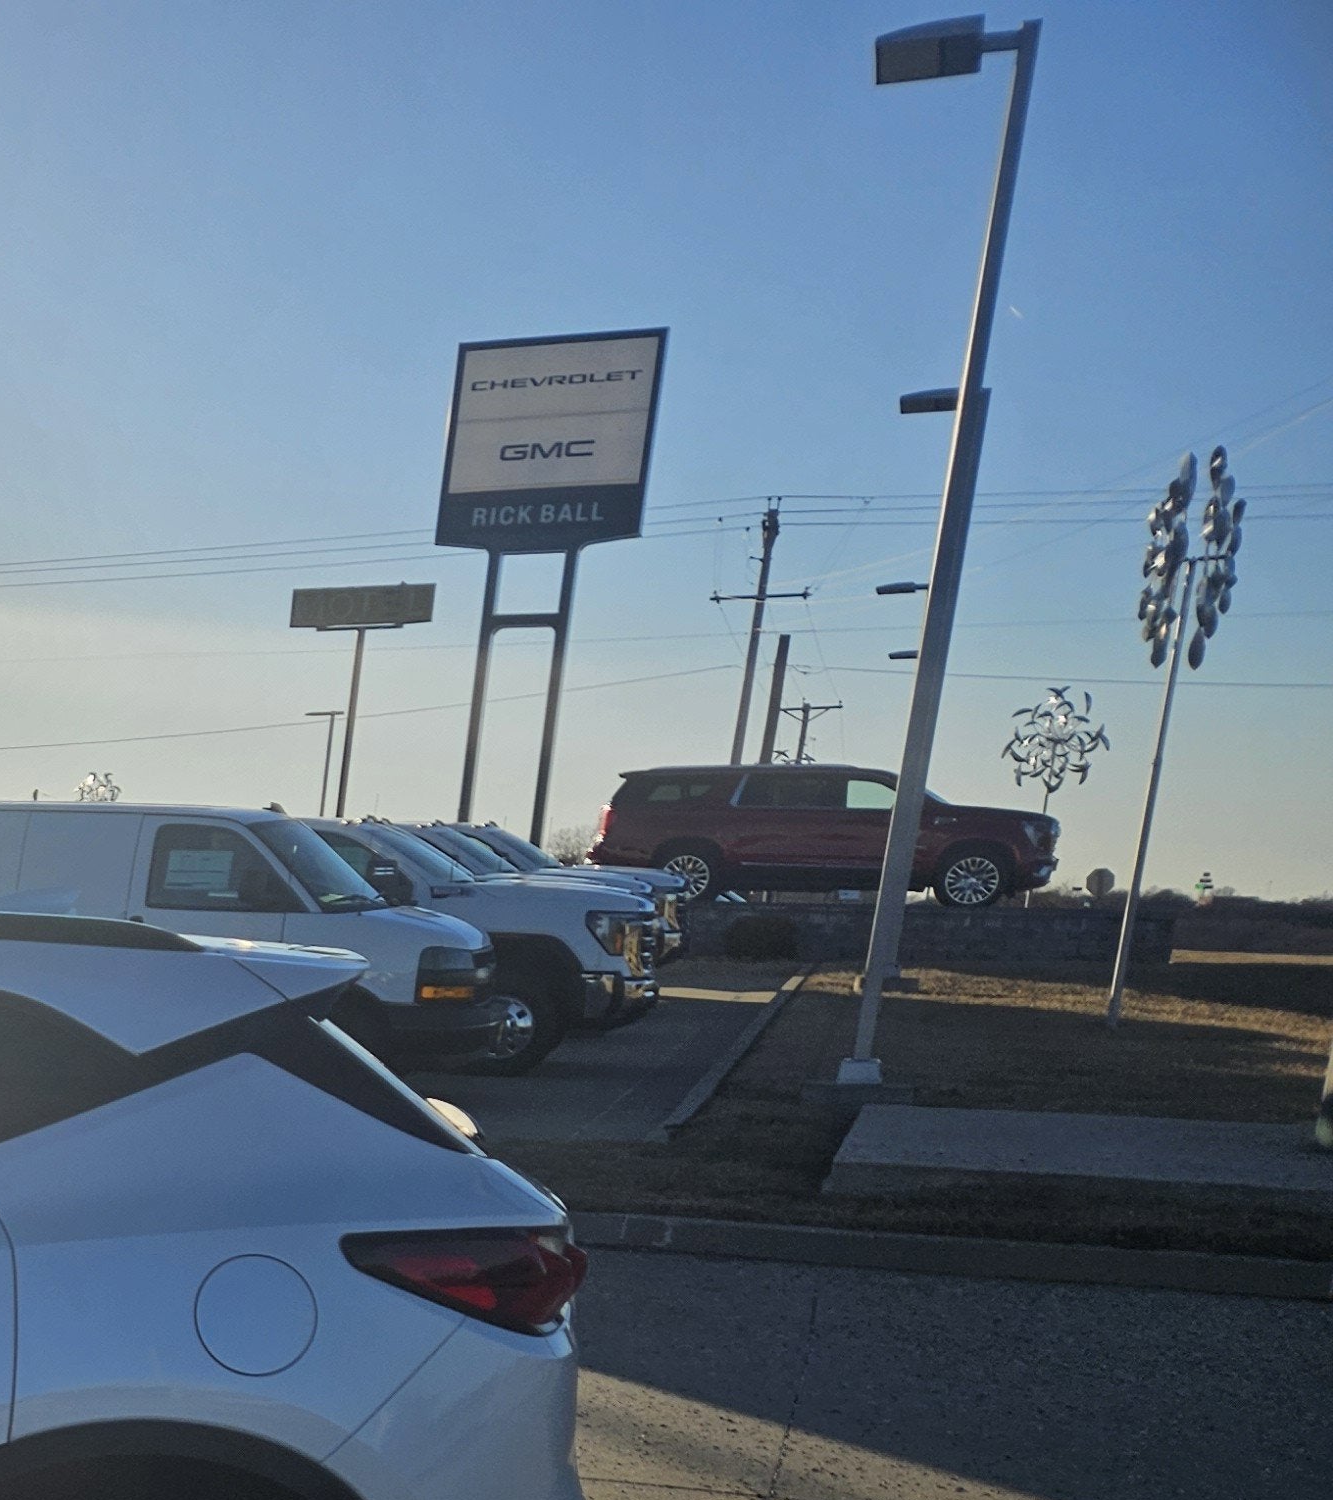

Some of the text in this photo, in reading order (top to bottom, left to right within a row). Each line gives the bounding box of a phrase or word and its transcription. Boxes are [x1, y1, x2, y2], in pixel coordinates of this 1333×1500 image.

[471, 369, 643, 392] CHEVROLET
[500, 440, 595, 462] GMC
[472, 502, 604, 528] RICK BALL
